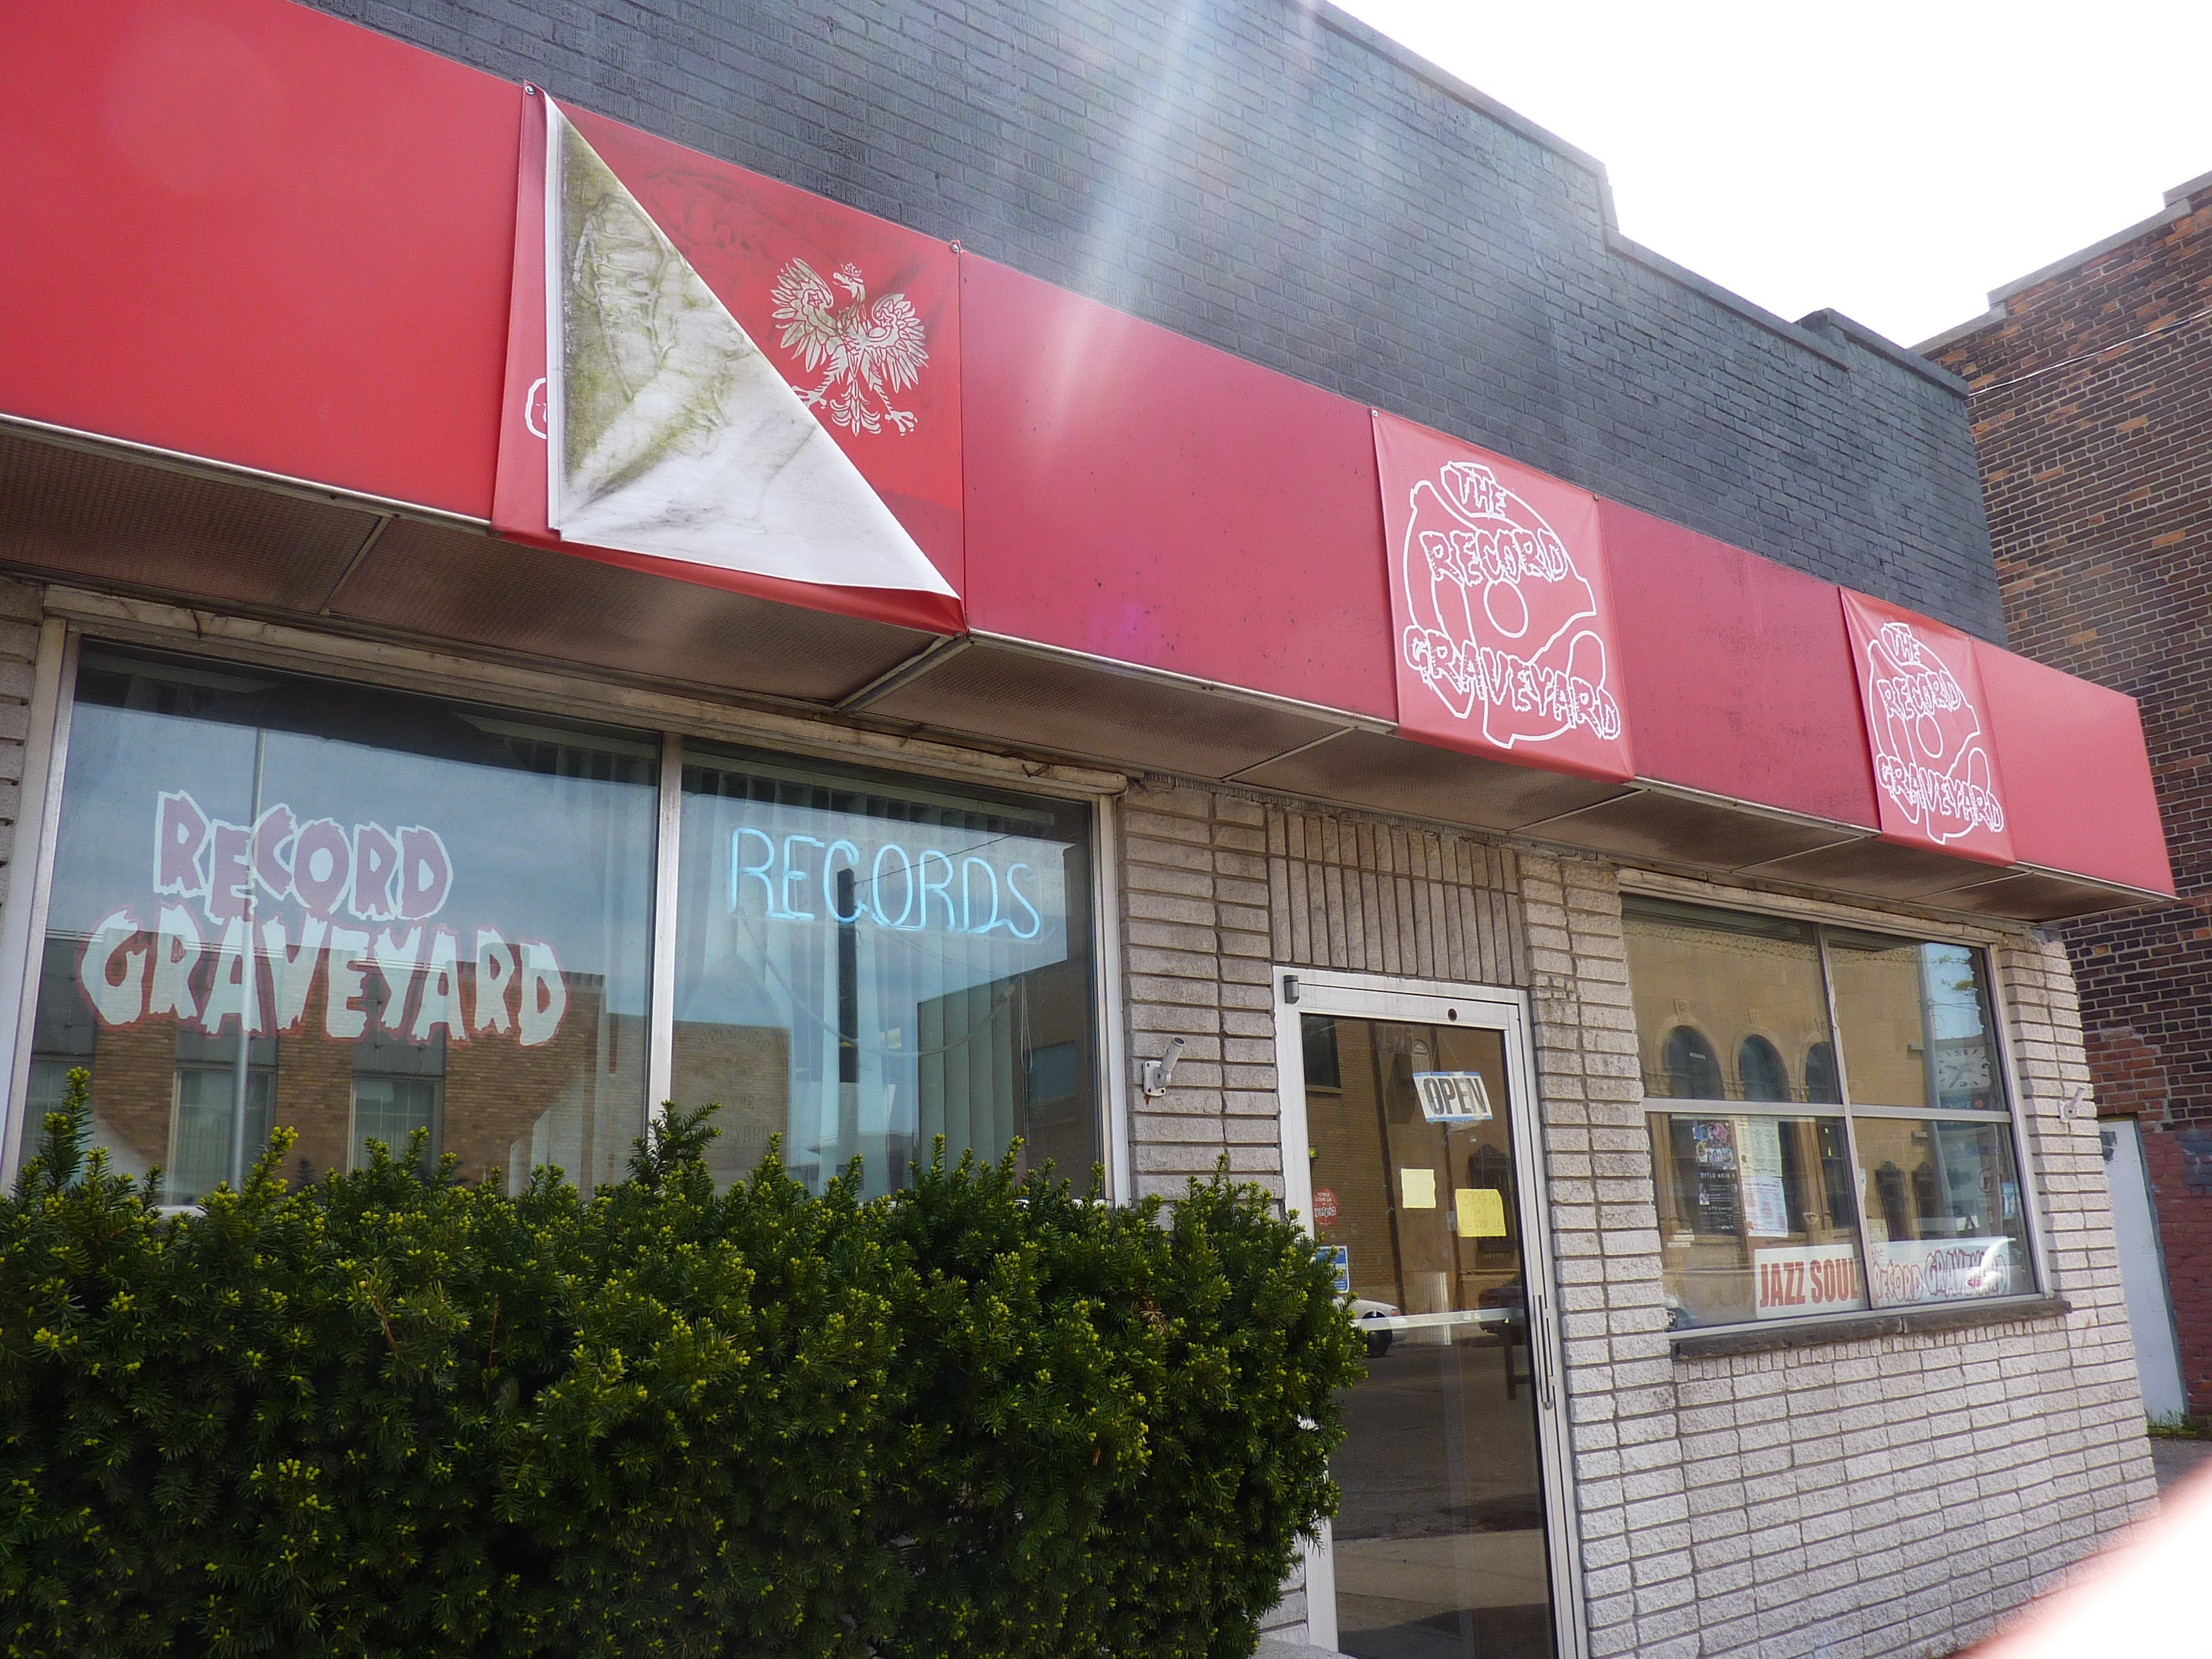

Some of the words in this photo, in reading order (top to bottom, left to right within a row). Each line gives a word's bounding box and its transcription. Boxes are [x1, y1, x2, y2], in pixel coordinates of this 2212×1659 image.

[1449, 463, 1507, 519] THE
[1419, 528, 1569, 586] RECORD
[1885, 624, 1922, 665] THE
[1403, 626, 1621, 740] GRAVEYARD
[1877, 669, 1961, 721] RECORD
[1875, 752, 2004, 833] GRAVEYARD
[153, 790, 454, 925] RECORD
[731, 827, 1041, 940] RECORDS
[78, 903, 571, 1048] GRAVEYARD
[1423, 1077, 1488, 1116] OPEN
[1872, 1247, 1884, 1261] the
[1760, 1261, 1806, 1308] JAZZ
[1809, 1258, 1859, 1304] SOUL
